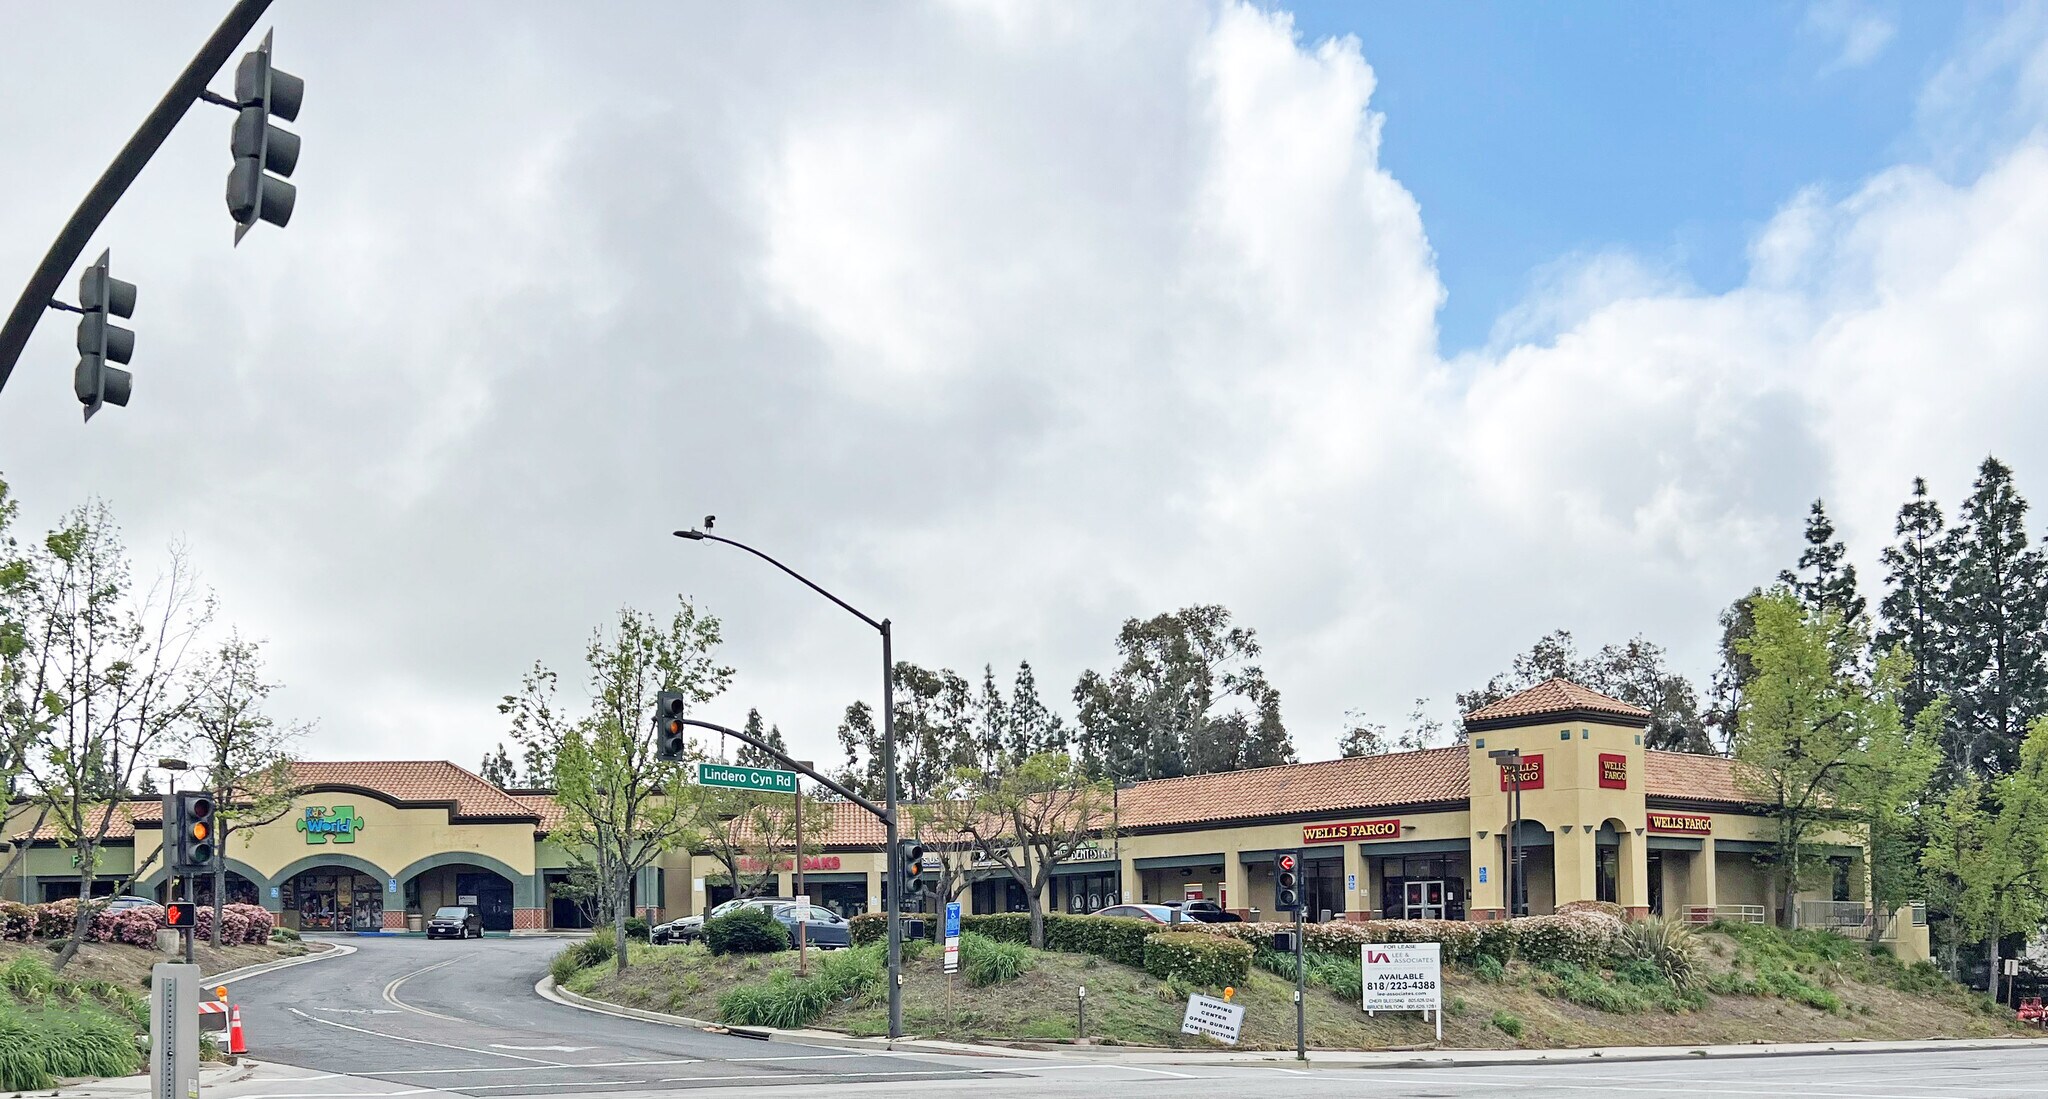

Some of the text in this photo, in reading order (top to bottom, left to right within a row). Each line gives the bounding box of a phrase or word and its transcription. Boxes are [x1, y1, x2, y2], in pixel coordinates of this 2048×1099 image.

[1603, 761, 1626, 771] WELLS
[704, 768, 791, 787] Lindero Cyn Rd
[1604, 770, 1626, 780] FARGO
[306, 818, 351, 834] World
[1653, 816, 1713, 830] WELLS FARGO
[1303, 823, 1396, 840] WELLS FARGO
[1367, 981, 1435, 991] 818/223-4388
[1200, 1001, 1232, 1013] SHOPPING
[1201, 1010, 1227, 1021] CENTER
[1189, 1016, 1235, 1031] OPEN DURING
[1185, 1023, 1235, 1040] CONSTRUCTION
